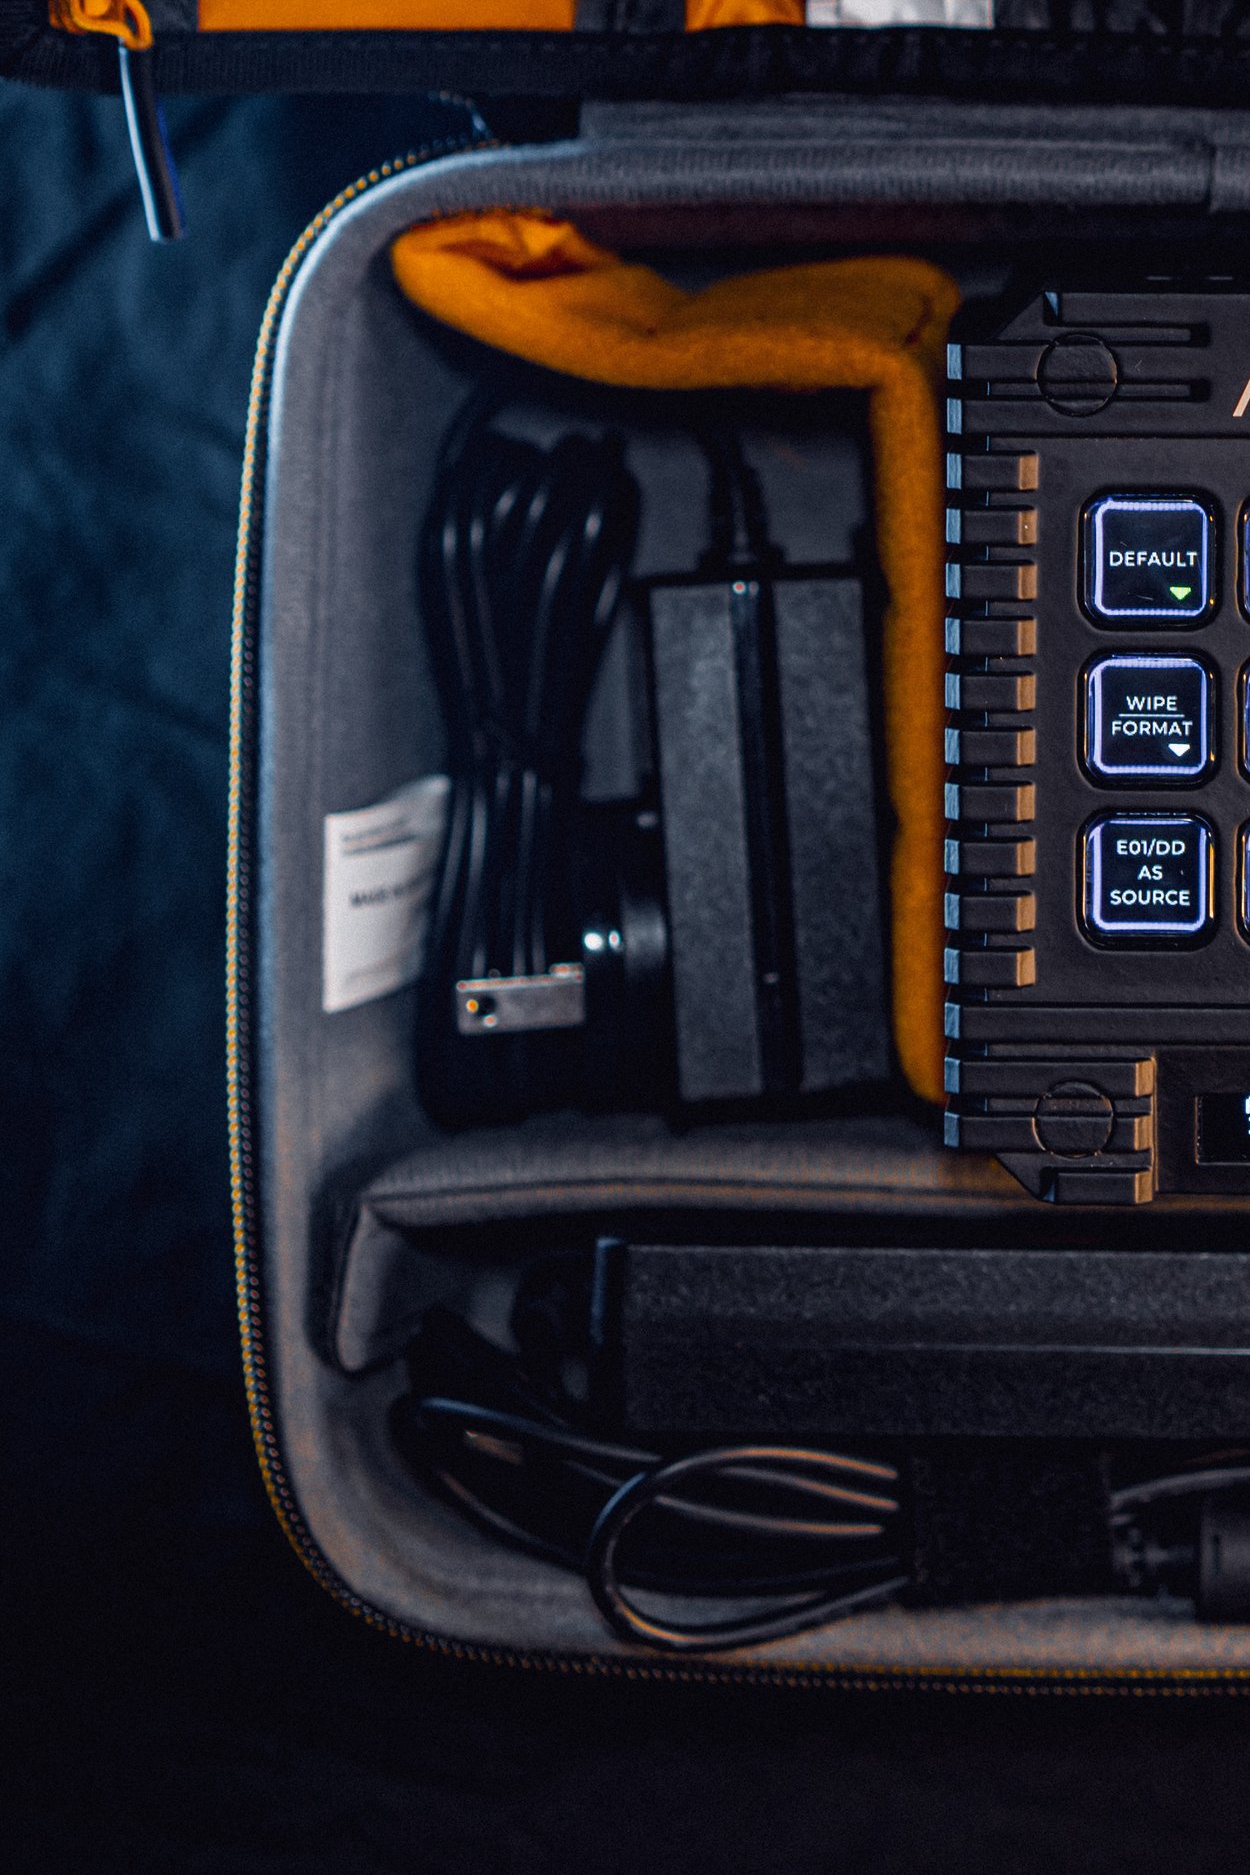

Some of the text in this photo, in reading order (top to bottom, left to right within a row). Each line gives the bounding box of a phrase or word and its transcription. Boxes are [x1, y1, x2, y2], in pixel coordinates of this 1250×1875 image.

[1108, 550, 1198, 569] DEFAULT
[1125, 695, 1178, 712] WIPE
[1111, 720, 1193, 737] FORMAT
[1137, 864, 1163, 881] AS
[1109, 889, 1191, 907] SOURCE
